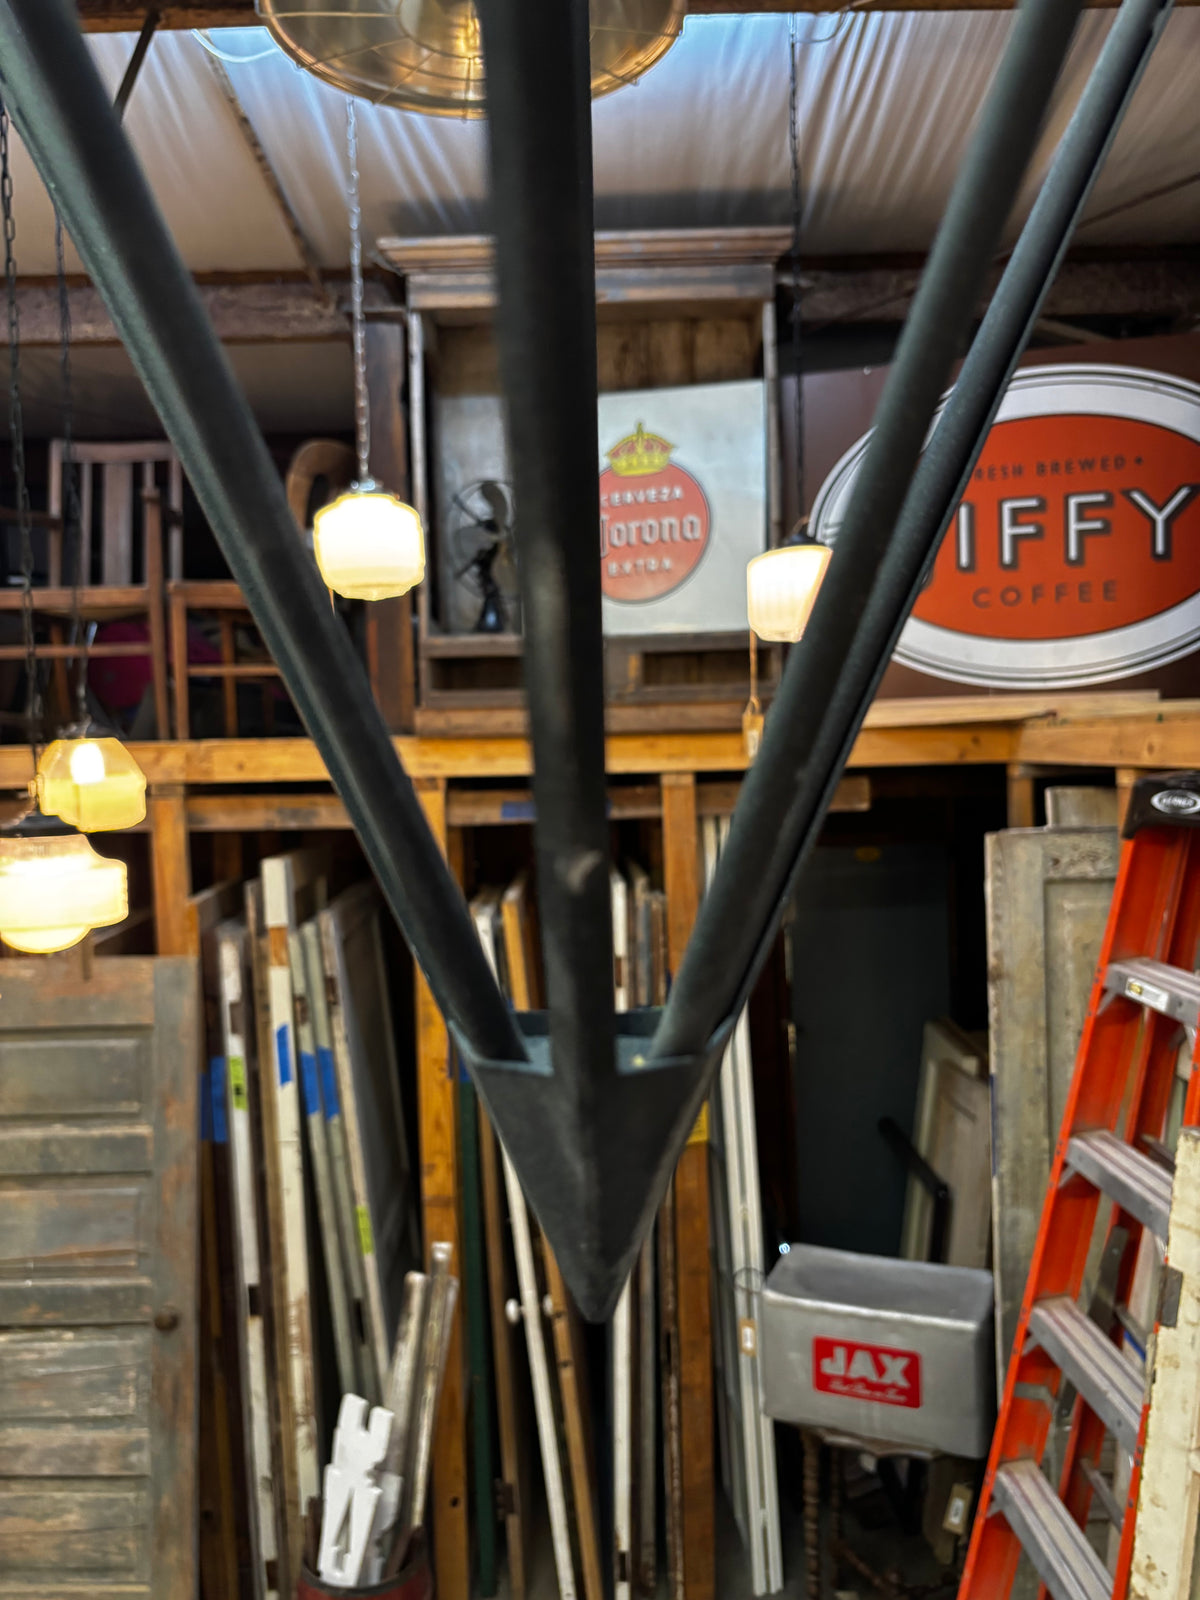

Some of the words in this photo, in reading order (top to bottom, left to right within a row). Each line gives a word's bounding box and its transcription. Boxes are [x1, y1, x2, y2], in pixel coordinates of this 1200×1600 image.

[974, 462, 1024, 482] RESH
[1036, 455, 1126, 477] BREWED
[954, 484, 1200, 573] IFFY
[607, 556, 674, 577] EXTRA
[972, 580, 1117, 608] COFFEE
[820, 1345, 911, 1388] JAX
